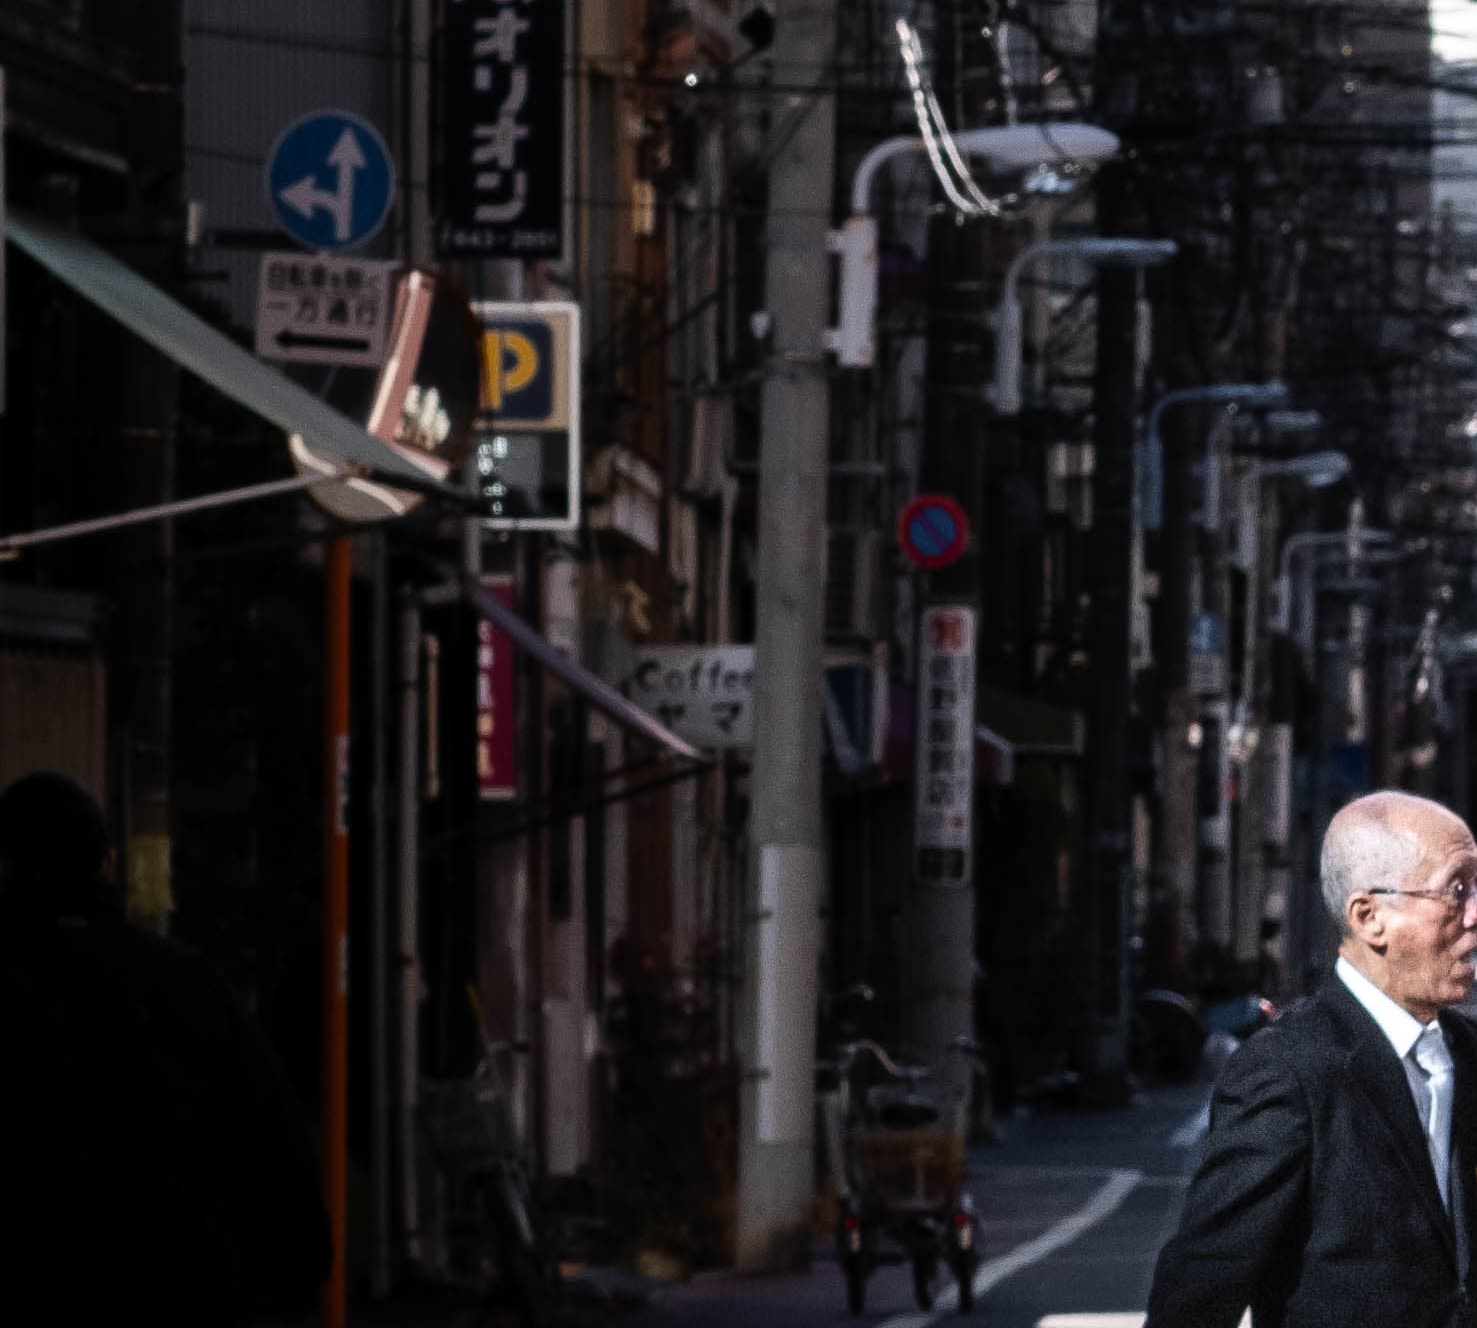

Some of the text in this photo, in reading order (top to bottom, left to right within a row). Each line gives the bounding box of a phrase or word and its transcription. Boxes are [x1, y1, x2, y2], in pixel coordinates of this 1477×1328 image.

[471, 8, 531, 224] オリオン
[266, 295, 379, 328] 一方通行
[482, 329, 539, 411] P
